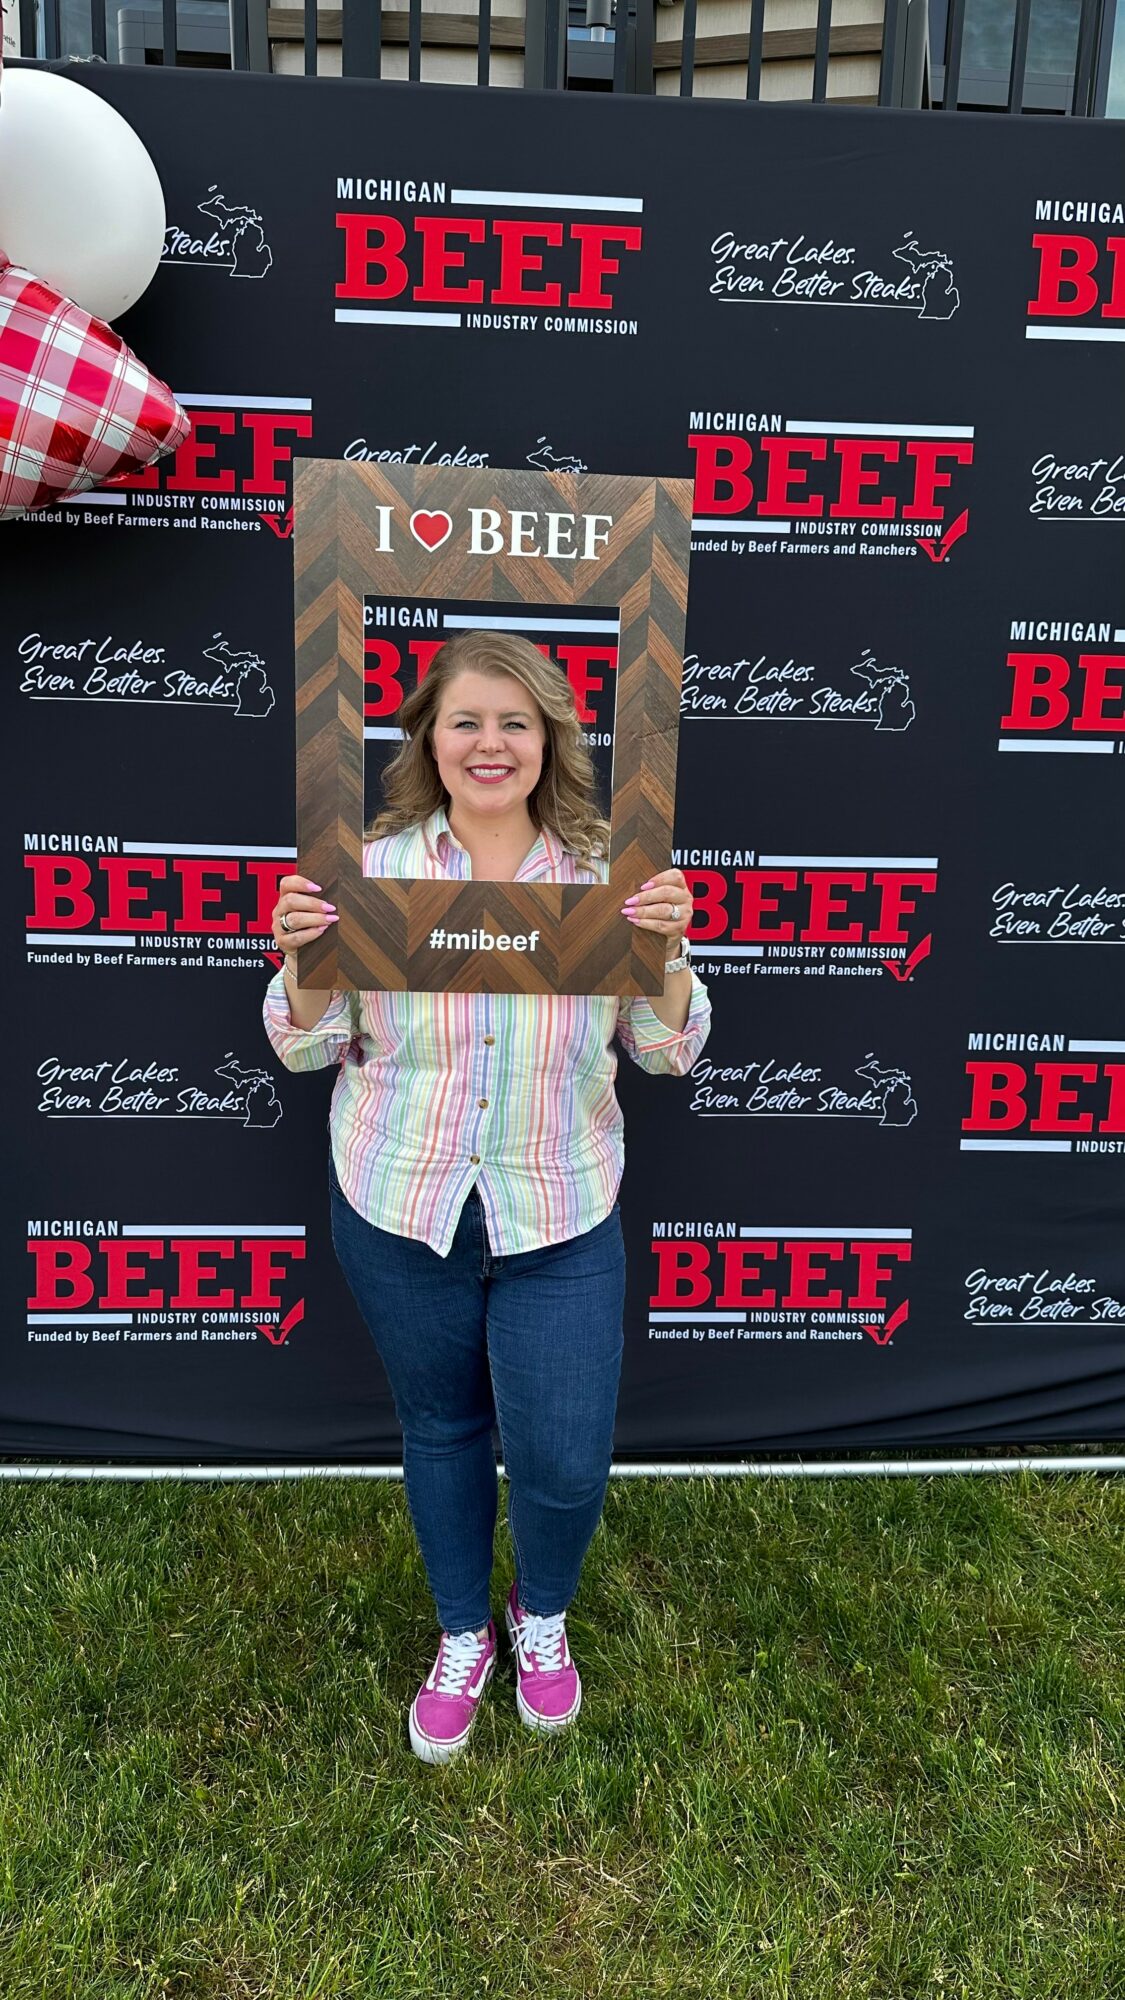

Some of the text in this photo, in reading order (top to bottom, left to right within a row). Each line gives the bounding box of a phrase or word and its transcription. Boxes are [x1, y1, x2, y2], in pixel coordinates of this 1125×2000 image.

[336, 177, 446, 204] MICHIGAN
[334, 211, 643, 310] BEEF
[710, 231, 856, 265] Great Lakes.
[709, 265, 921, 300] Even Better Steaks.
[466, 313, 638, 335] INDUSTRY COMMISSION
[689, 411, 782, 433] MICHIGAN
[98, 411, 313, 495] EF
[687, 433, 974, 519] BEEF
[1031, 453, 1108, 485] Great
[131, 493, 285, 513] INDUSTRY COMMISSION
[1028, 485, 1084, 514] Even
[66, 511, 80, 526] by
[84, 512, 114, 525] Beef
[117, 513, 170, 528] Farmers
[173, 516, 197, 529] and
[200, 516, 262, 532] Ranchers
[374, 505, 614, 561] I BEEF
[795, 521, 942, 537] INDUSTRY COMMISSION
[731, 539, 746, 555] by
[748, 540, 778, 553] Beef
[779, 541, 830, 555] Farmers
[832, 542, 856, 555] and
[859, 542, 918, 556] Ranchers
[1009, 620, 1111, 643] MICHIGAN
[17, 633, 166, 664] Great Lakes.
[19, 664, 235, 698] Even Better Steaks.
[682, 654, 815, 685] Great Lakes.
[680, 685, 878, 715] Even Better Steaks.
[23, 833, 119, 853] MICHIGAN
[672, 848, 756, 868] MICHIGAN
[684, 869, 937, 943] BEEF
[991, 882, 1068, 911] Great
[989, 911, 1041, 937] Even
[1046, 911, 1116, 938] Better
[140, 935, 202, 949] INDUSTRY
[428, 928, 541, 952] #mibeef
[767, 945, 907, 959] INDUSTRY COMMISSION
[27, 951, 265, 968] Funded by Beef Farmers and Ranchers
[707, 962, 722, 976] by
[723, 962, 752, 974] Beef
[753, 963, 801, 975] Farmers
[803, 964, 826, 976] and
[828, 964, 883, 976] Ranchers
[967, 1032, 1065, 1052] MICHIGAN
[36, 1057, 179, 1086] Great Lakes.
[692, 1058, 822, 1085] Great Lakes.
[37, 1083, 245, 1113] Even Better Steaks.
[689, 1085, 882, 1112] Even Better Steaks.
[1076, 1140, 1125, 1154] INDUST
[27, 1220, 118, 1237] MICHIGAN
[652, 1221, 736, 1238] MICHIGAN
[27, 1240, 306, 1309] BEEF
[649, 1241, 912, 1309] BEEF
[964, 1268, 1096, 1298] Great Lakes.
[137, 1312, 280, 1324] INDUSTRY COMMISSION
[750, 1311, 885, 1324] INDUSTRY COMMISSION
[963, 1295, 1014, 1320] Even
[1019, 1295, 1085, 1321] Better
[27, 1329, 258, 1344] Funded by Beef Farmers and Ranchers
[648, 1328, 863, 1342] Funded by Beef Farmers and Ranchers
